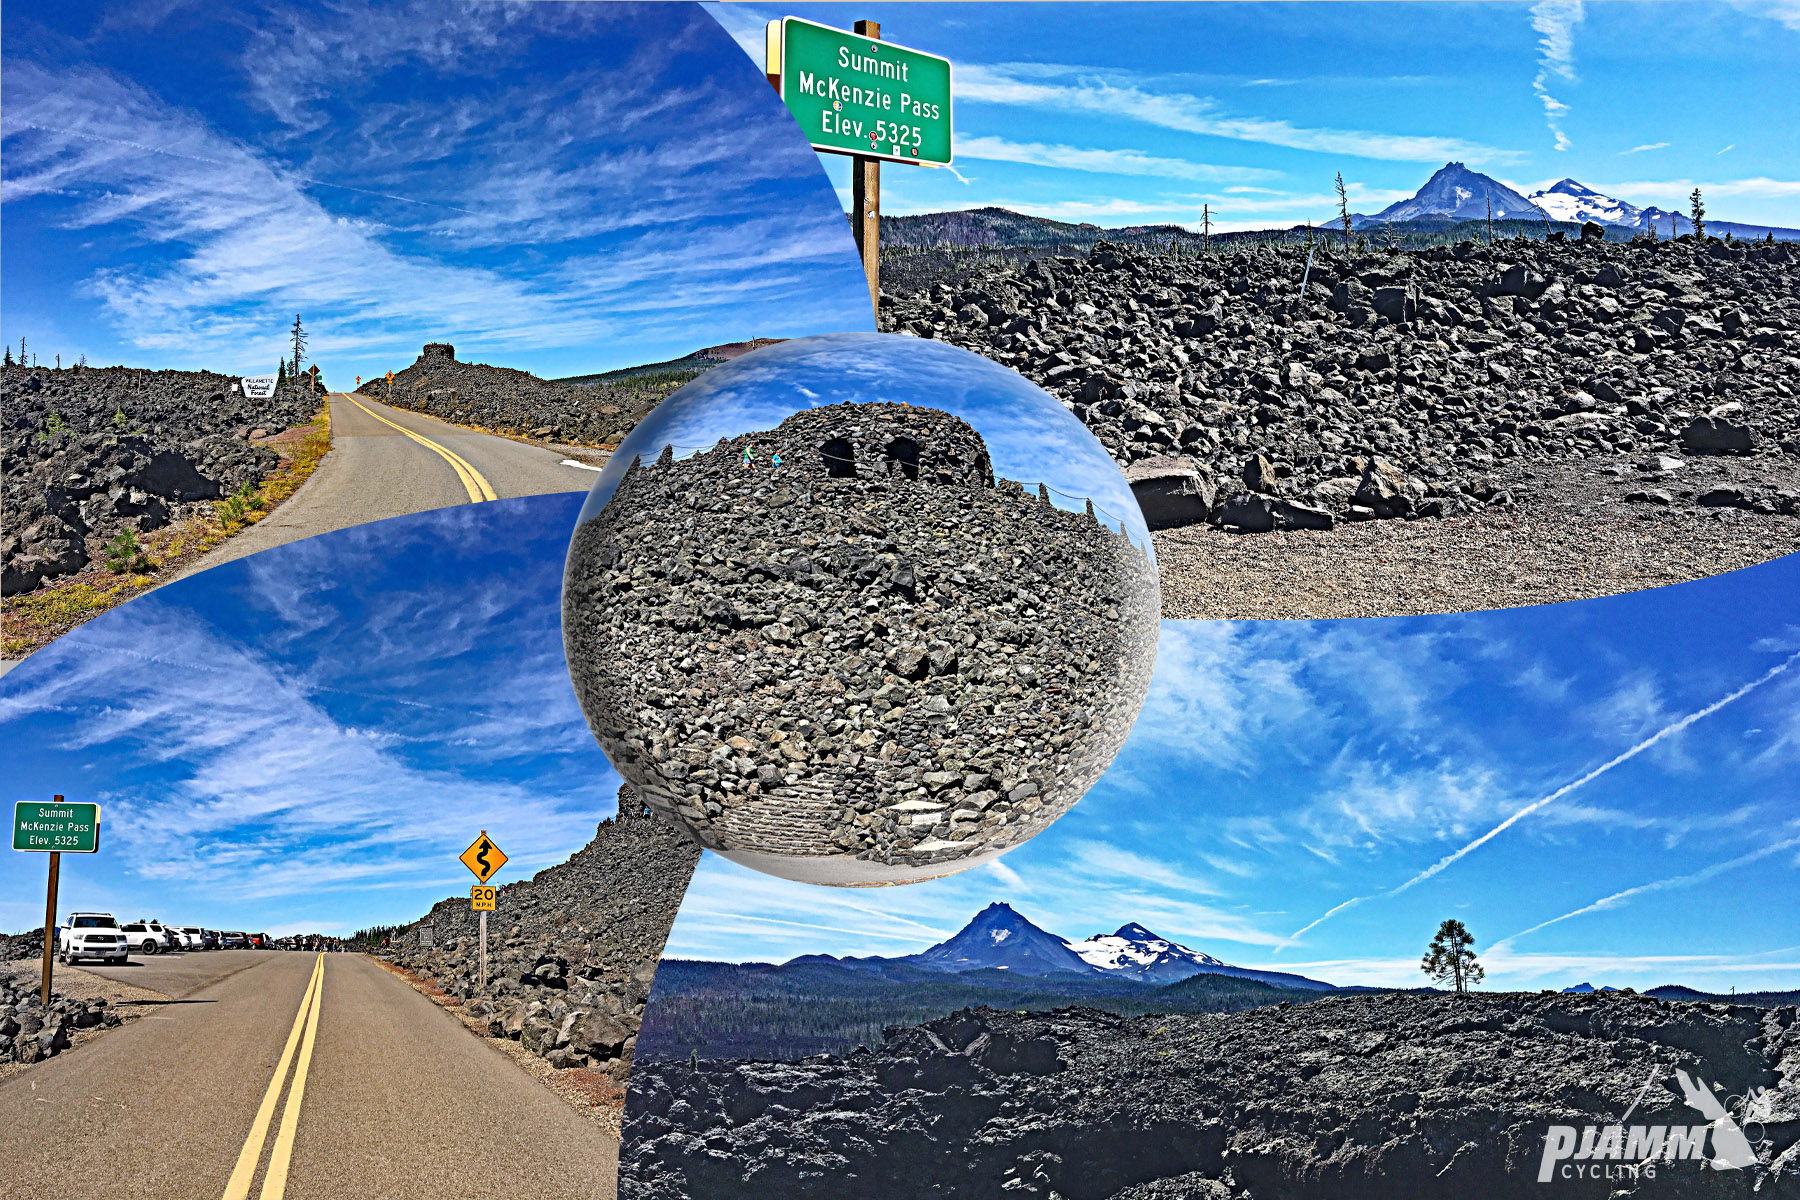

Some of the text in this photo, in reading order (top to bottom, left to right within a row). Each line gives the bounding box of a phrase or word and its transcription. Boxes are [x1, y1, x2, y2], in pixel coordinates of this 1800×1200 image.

[838, 46, 908, 82] Summit
[799, 70, 940, 120] McKenzie Pass
[822, 110, 922, 147] Elev. 5325
[38, 808, 74, 818] Summit
[20, 821, 89, 832] McKenzie Pass
[29, 835, 79, 846] Elev. 5325
[474, 889, 494, 900] 20
